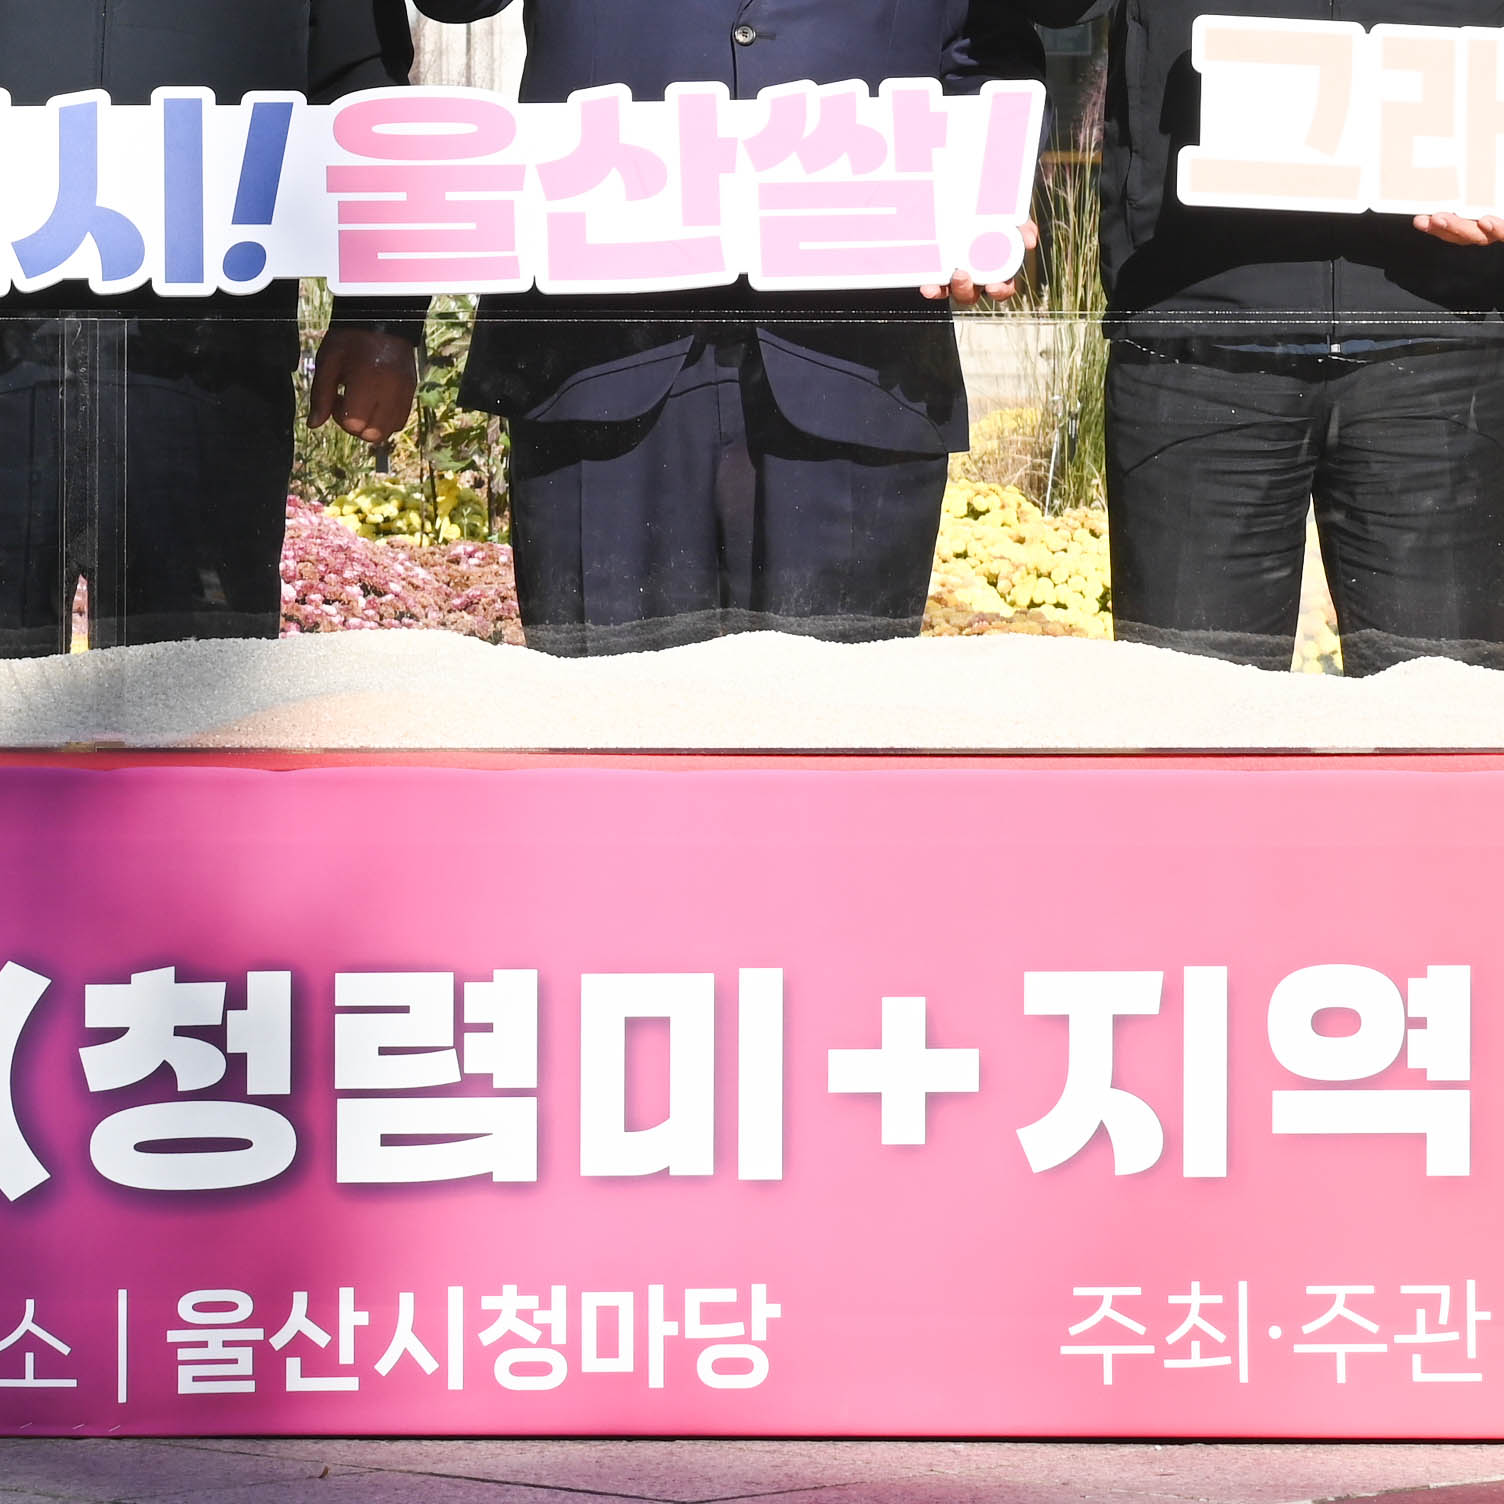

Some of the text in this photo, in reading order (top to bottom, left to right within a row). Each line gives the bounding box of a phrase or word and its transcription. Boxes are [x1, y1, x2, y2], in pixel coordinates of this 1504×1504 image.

[326, 89, 1033, 283] 울산쌀!
[167, 1284, 782, 1394] 울산시청마당
[1060, 1278, 1492, 1385] 주최·주관
